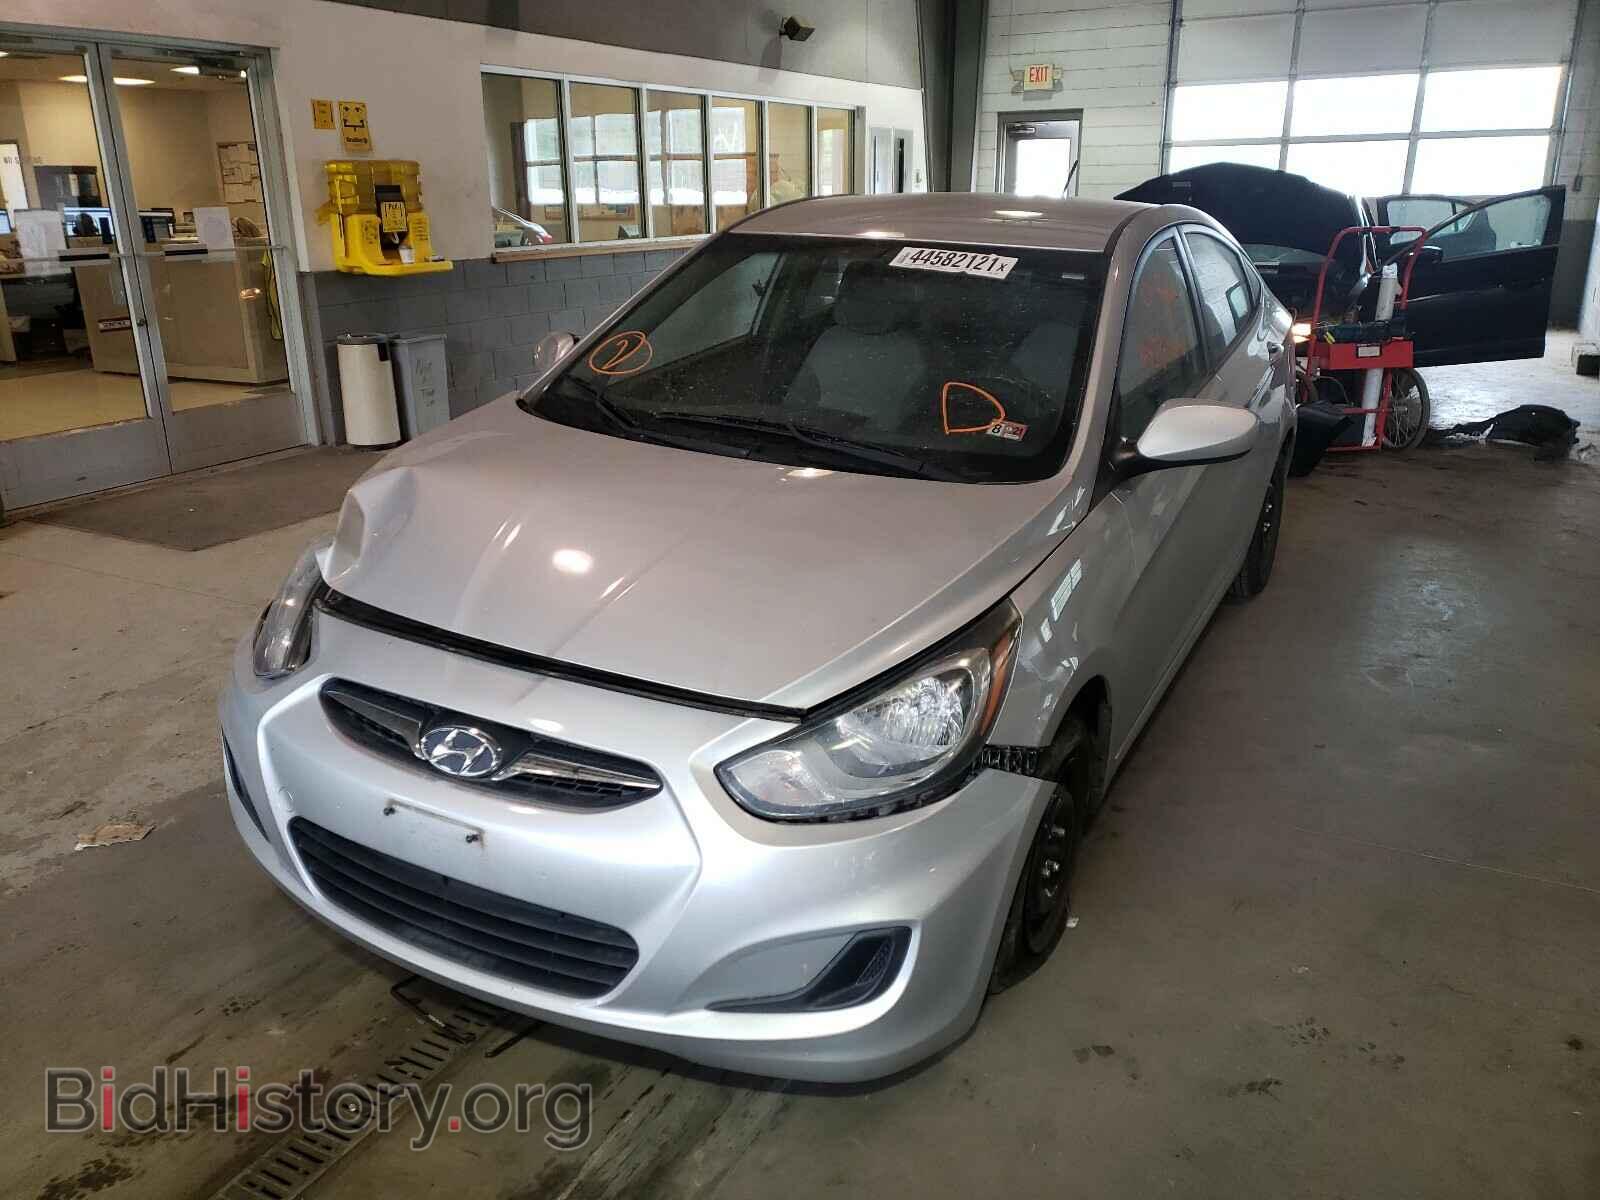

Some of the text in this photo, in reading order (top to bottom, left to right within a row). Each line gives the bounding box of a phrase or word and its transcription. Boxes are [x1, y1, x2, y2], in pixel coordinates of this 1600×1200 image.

[1029, 66, 1048, 82] EXIT
[910, 249, 999, 271] 44582121
[992, 424, 1002, 434] 8
